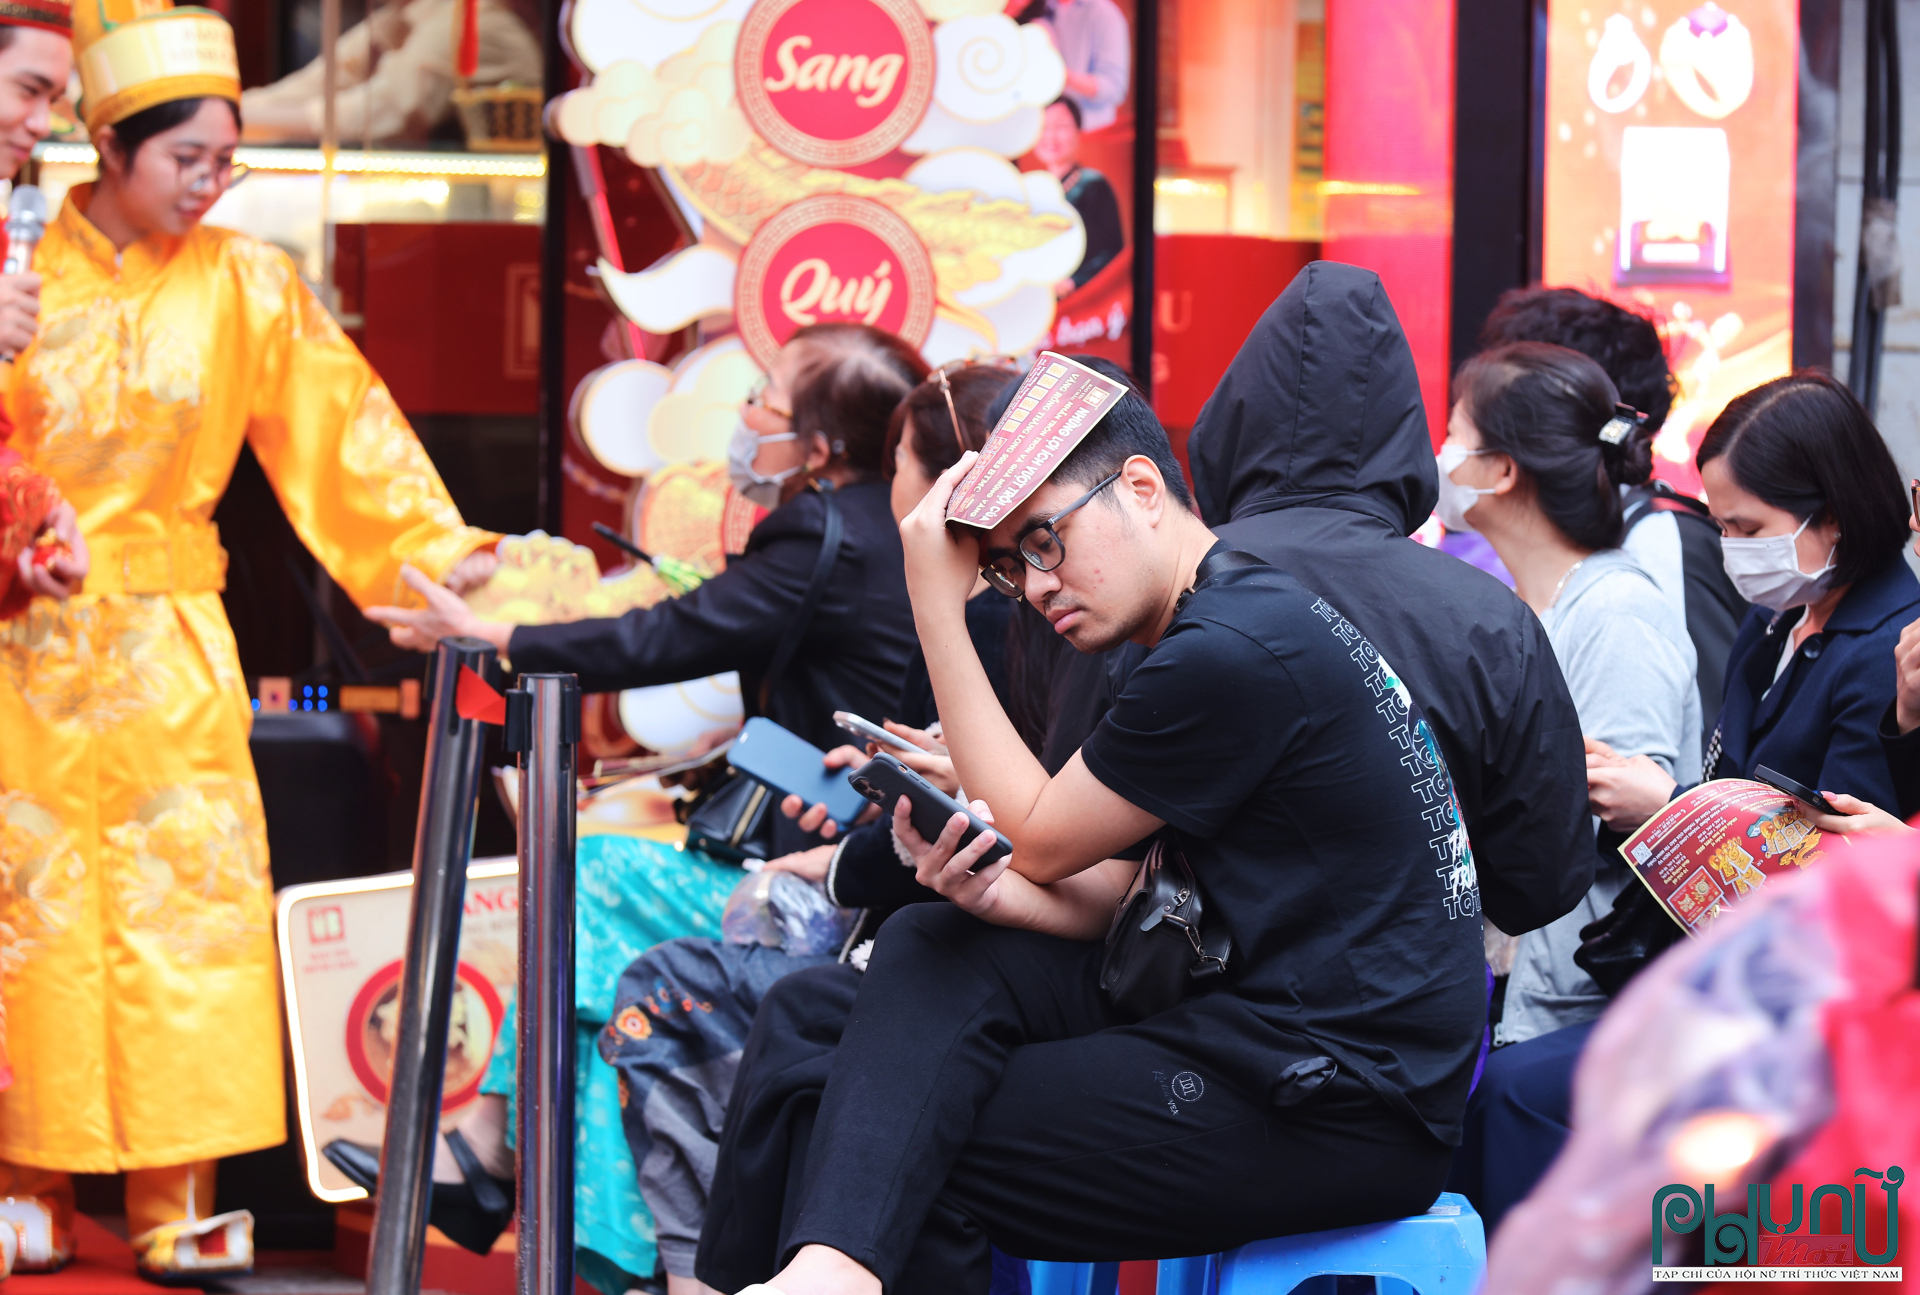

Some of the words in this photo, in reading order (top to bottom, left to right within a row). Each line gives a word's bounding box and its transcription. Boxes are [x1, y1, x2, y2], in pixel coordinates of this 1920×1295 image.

[765, 35, 904, 108] Sang
[780, 258, 892, 326] Quý
[1059, 372, 1079, 392] VÀNG
[1041, 391, 1061, 411] RỒNG
[1053, 401, 1073, 420] NHẪN
[1021, 410, 1045, 434] THĂNG
[1039, 419, 1056, 437] TRÒN
[1057, 406, 1089, 437] NHỮNG
[1005, 433, 1025, 454] LONG
[1023, 436, 1041, 454] TRƠN
[1044, 435, 1063, 450] LỢI
[992, 452, 1008, 469] 999.9
[1015, 453, 1026, 461] VÀ
[1031, 448, 1053, 466] ÍCH
[1002, 462, 1017, 478] QUÀ
[1012, 464, 1038, 488] VƯỢT
[973, 468, 995, 493] BTMC
[986, 477, 1005, 498] MỪNG
[995, 485, 1019, 507] TRỘI
[969, 500, 988, 516] VÀNG
[978, 506, 1000, 520] CỦA
